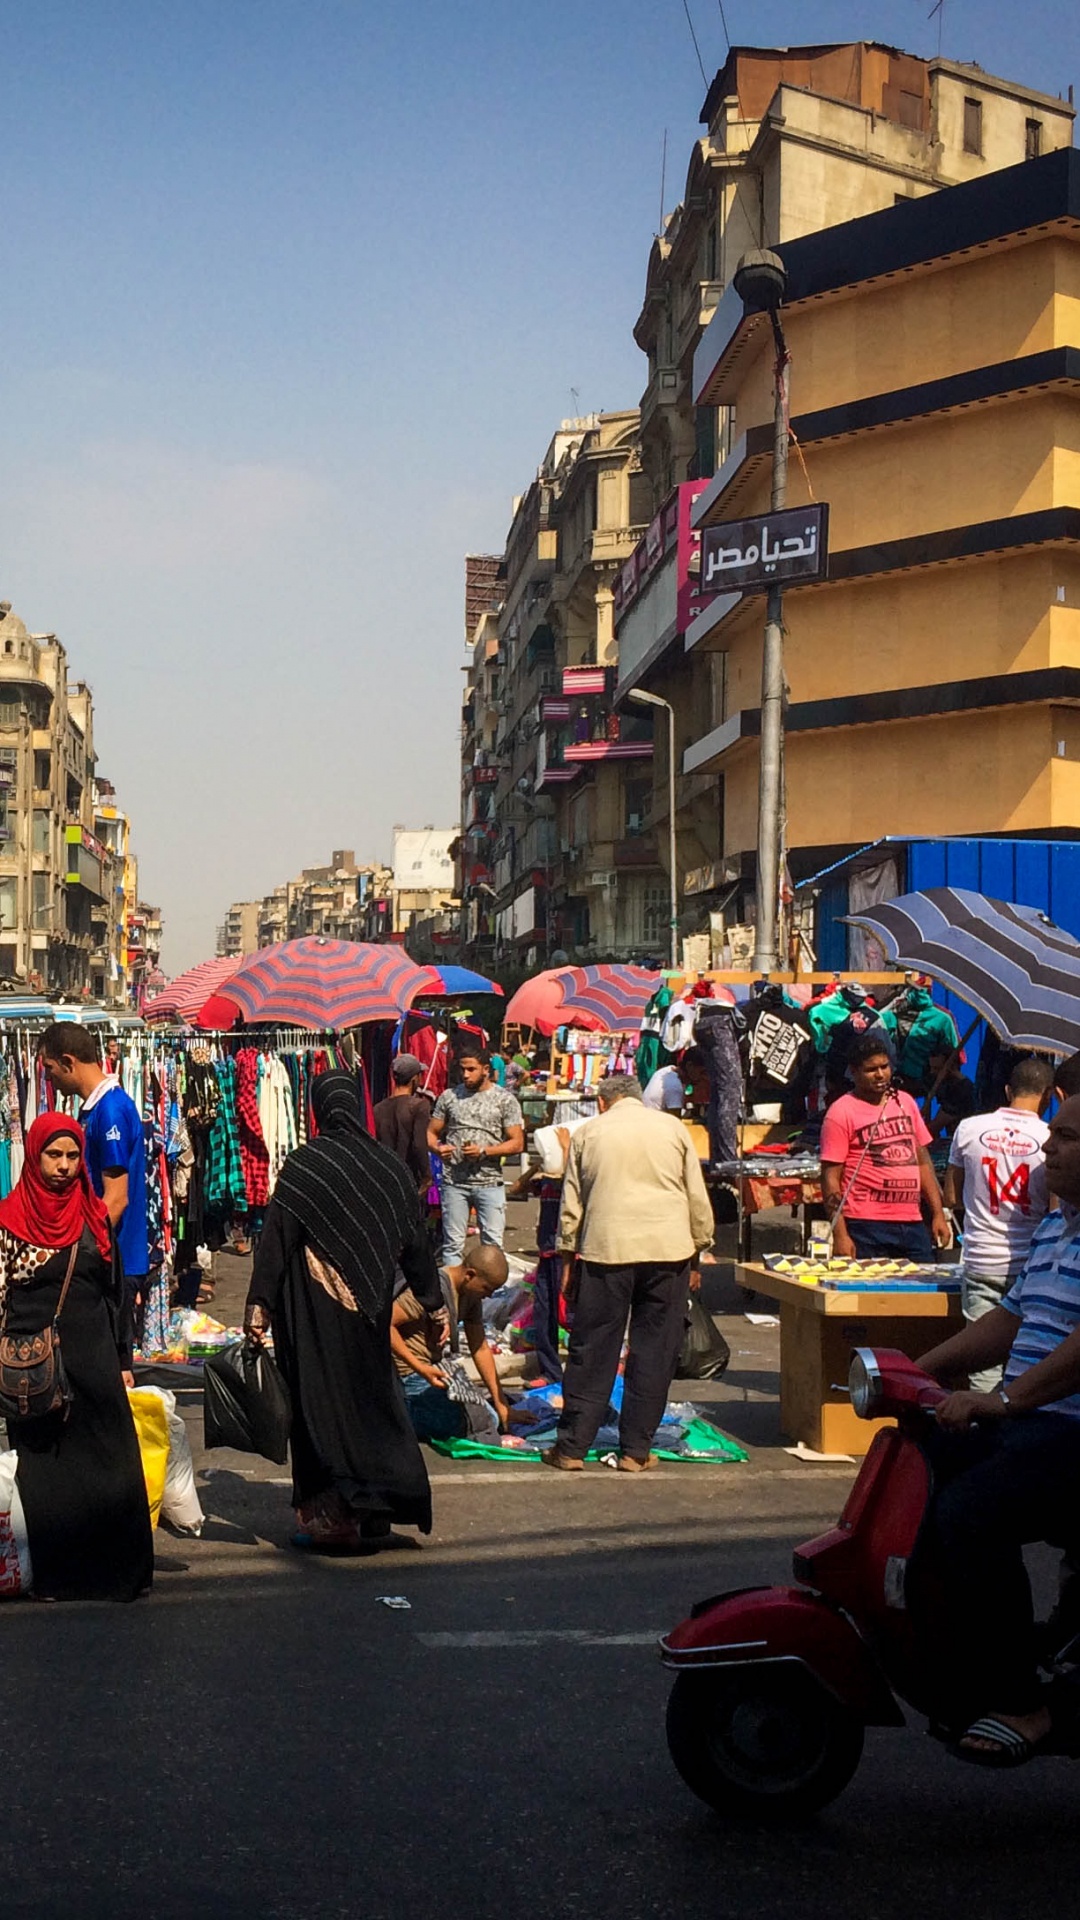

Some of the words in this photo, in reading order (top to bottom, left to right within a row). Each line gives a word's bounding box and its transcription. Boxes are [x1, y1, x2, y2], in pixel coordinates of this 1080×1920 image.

[705, 547, 759, 582] مصر
[762, 526, 817, 572] تحيا
[754, 1013, 782, 1059] WHO
[981, 1156, 1031, 1216] 14
